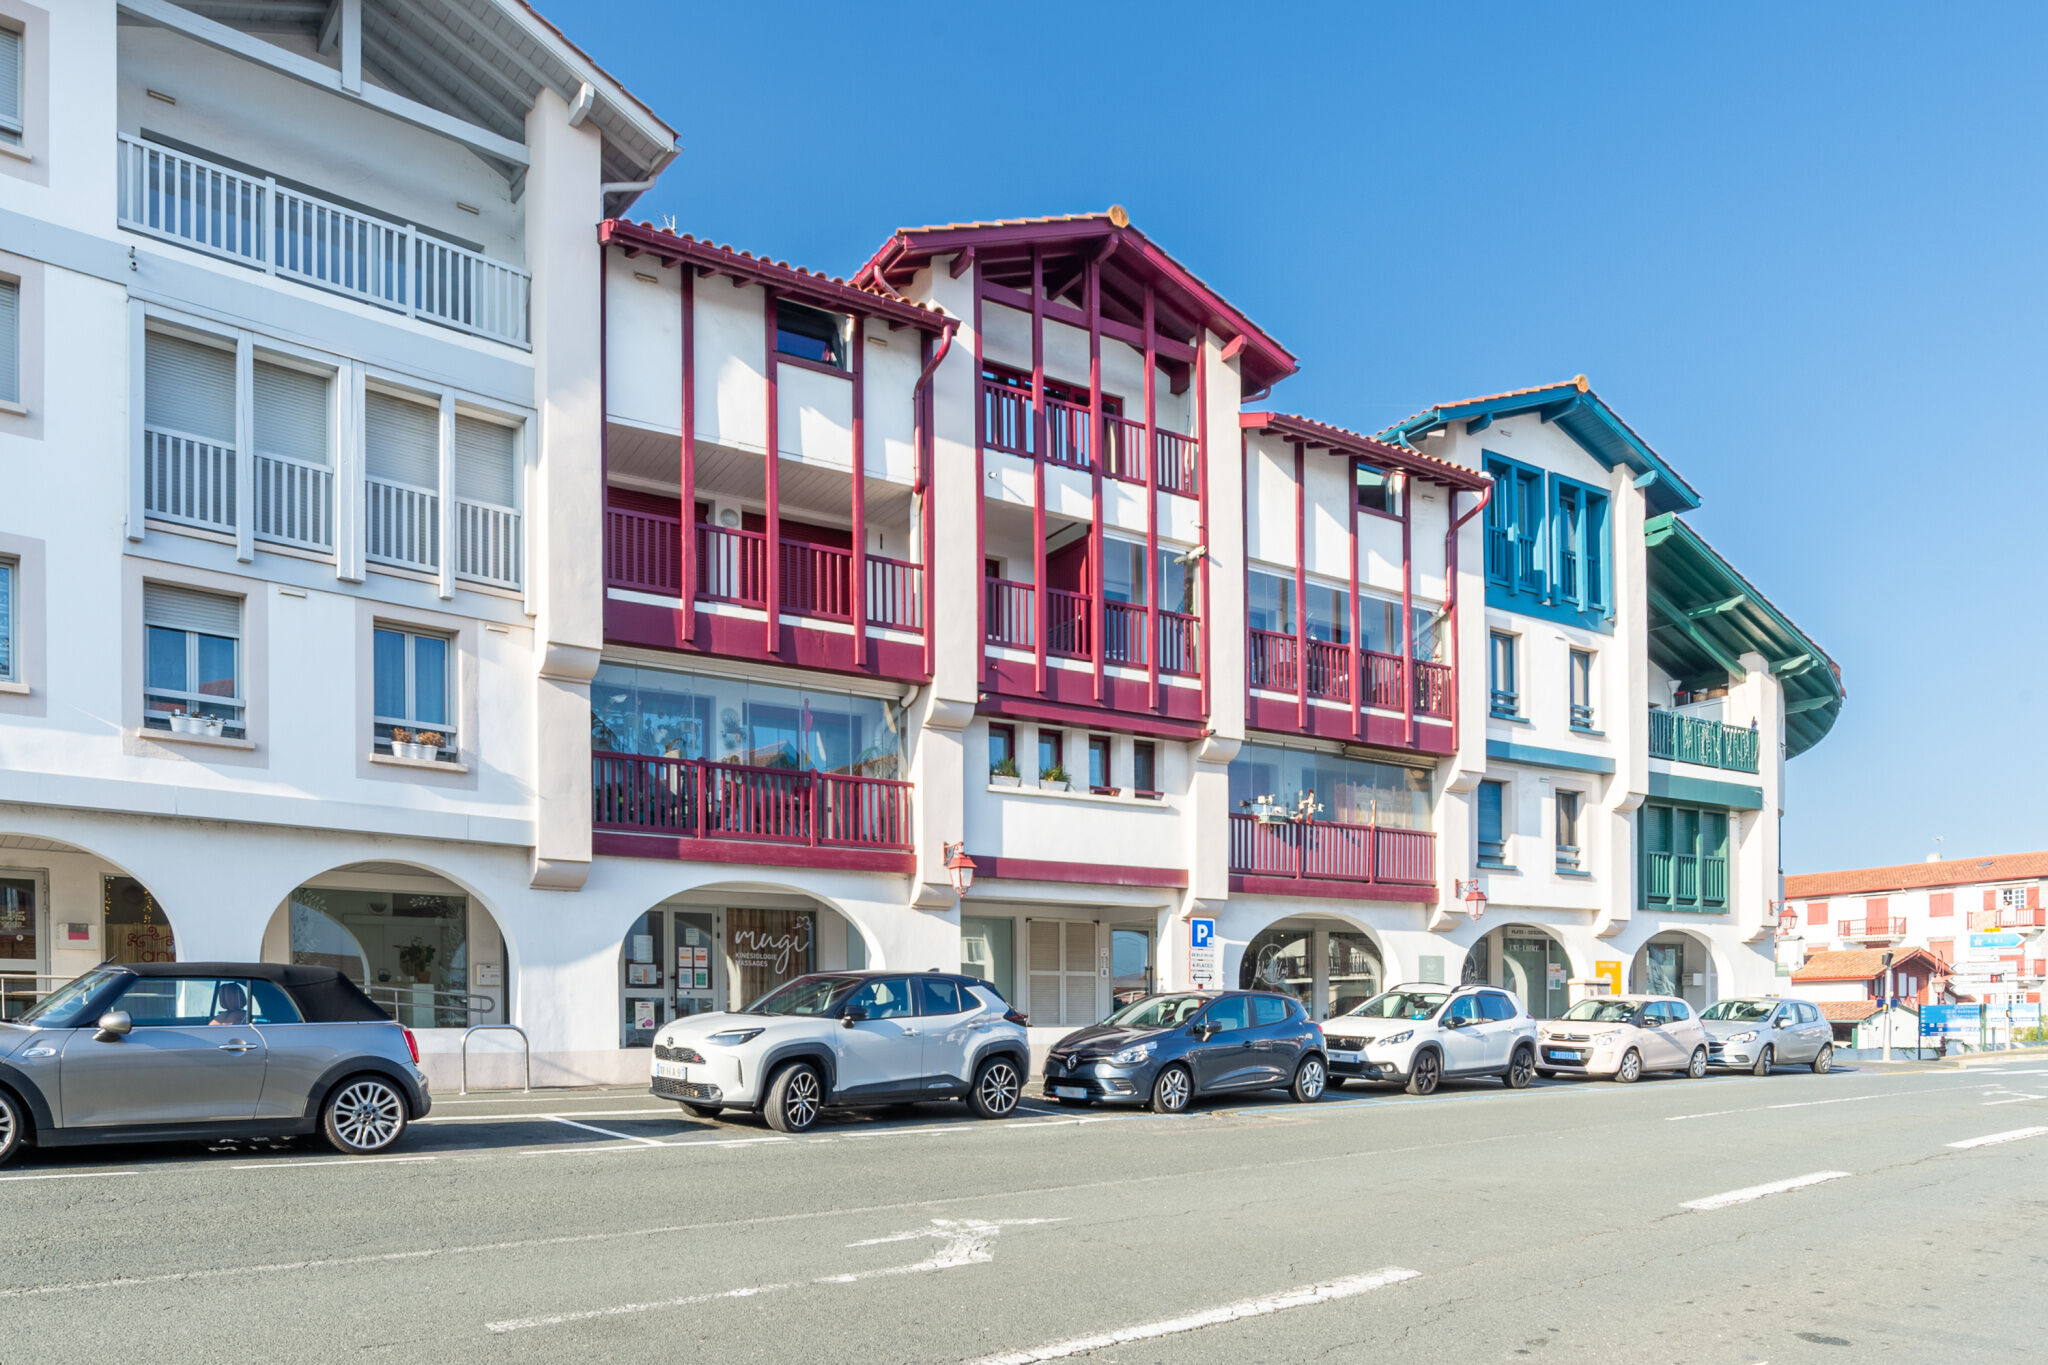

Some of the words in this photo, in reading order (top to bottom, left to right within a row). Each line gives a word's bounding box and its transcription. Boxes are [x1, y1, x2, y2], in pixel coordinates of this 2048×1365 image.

[1197, 924, 1208, 943] P
[735, 929, 810, 975] mugi
[735, 952, 777, 961] KINESIOLOGIE
